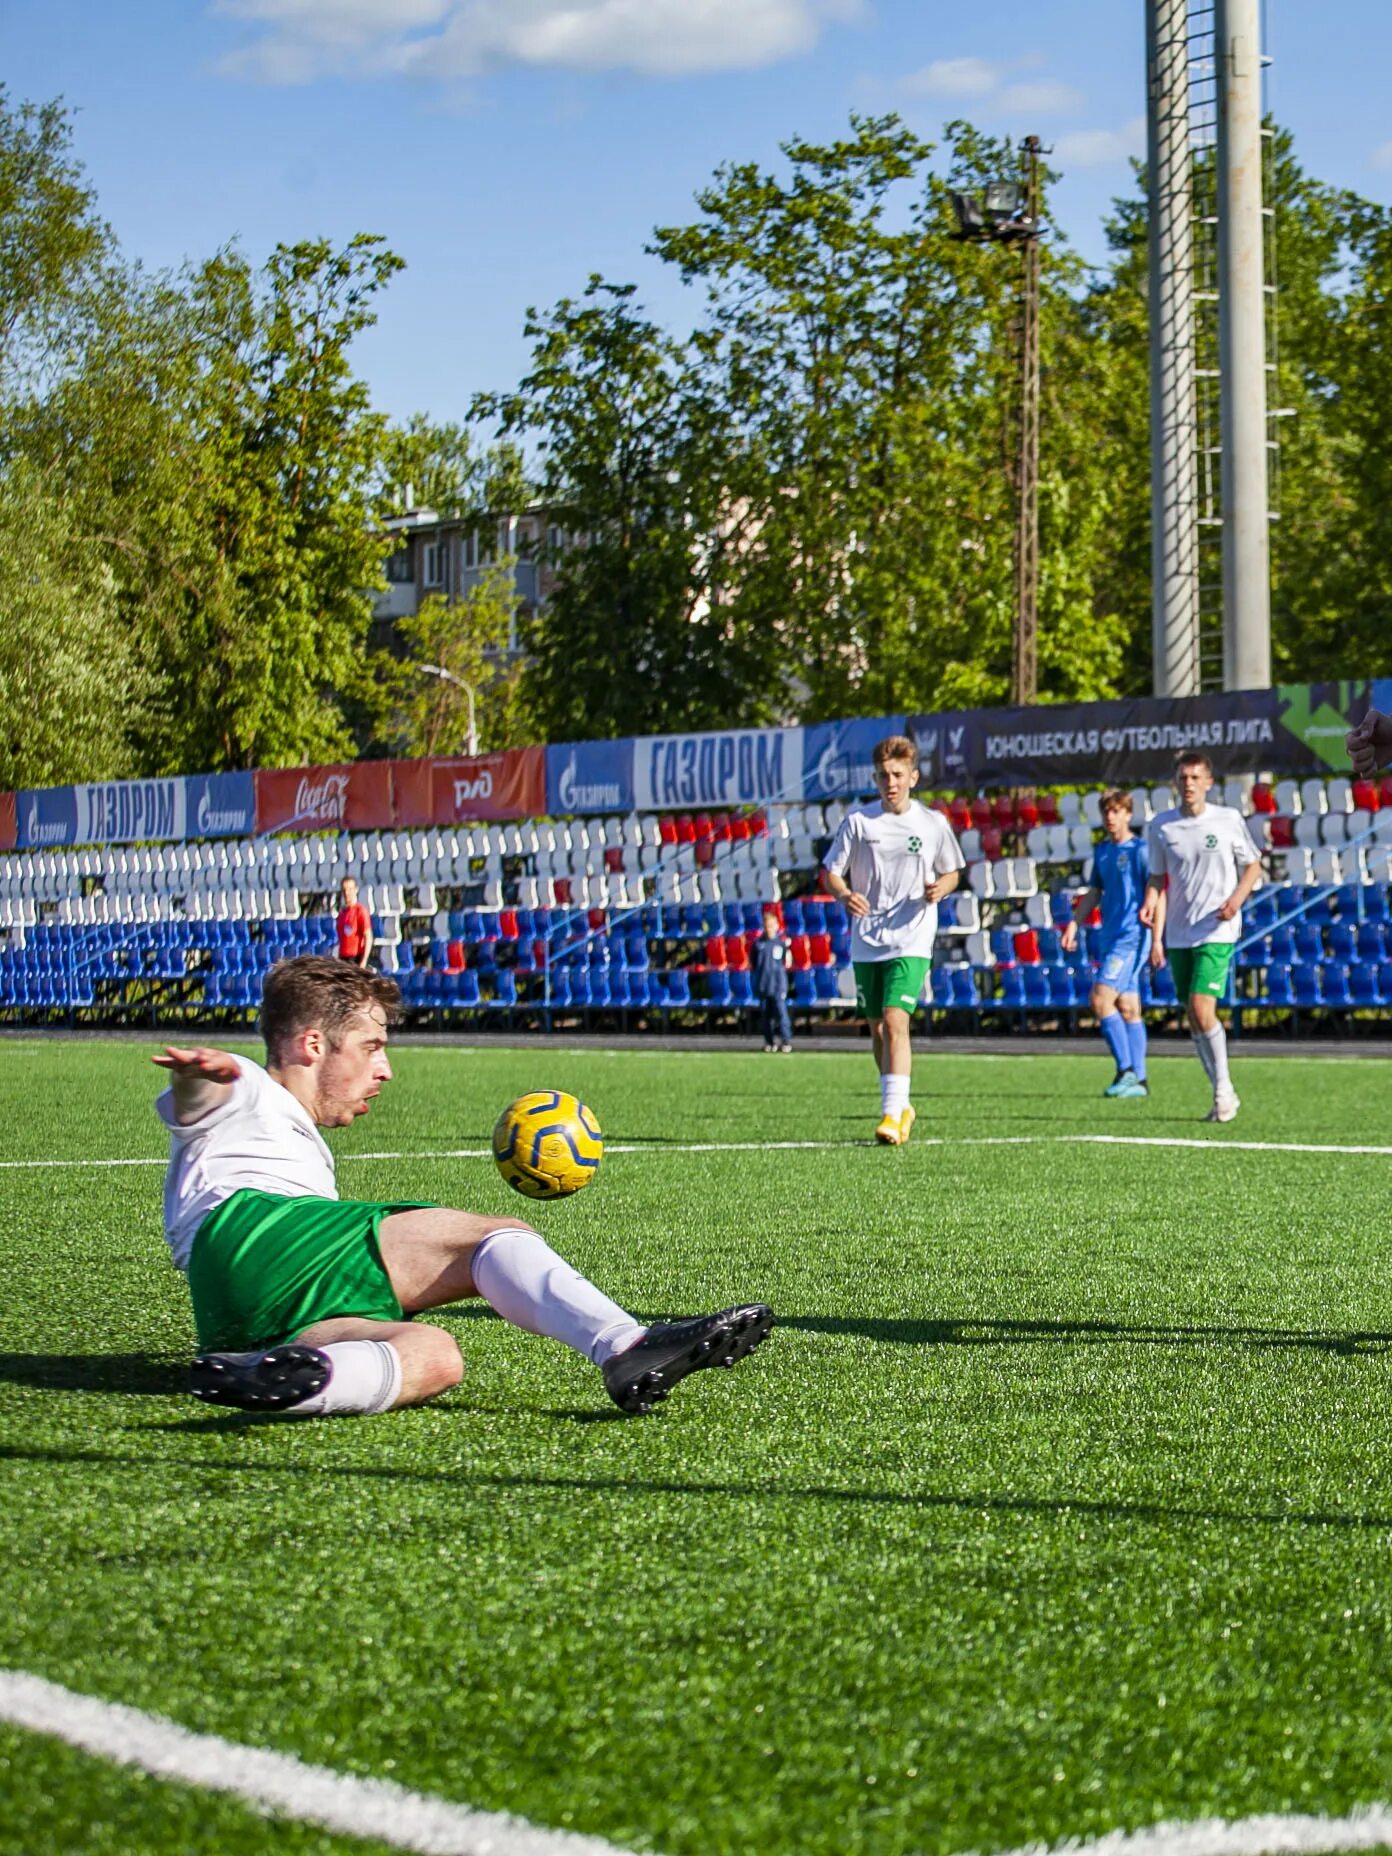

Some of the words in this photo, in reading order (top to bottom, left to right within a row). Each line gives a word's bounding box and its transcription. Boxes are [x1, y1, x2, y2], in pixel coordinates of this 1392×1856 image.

[649, 731, 785, 804] ГАЗПРОМ
[985, 730, 1099, 760] ЮНОШЕСКАЯ
[1101, 721, 1223, 753] ФУТБОЛЬНАЯ
[1225, 717, 1274, 744] ЛИГА
[86, 781, 176, 841] ГАЗПРОМ
